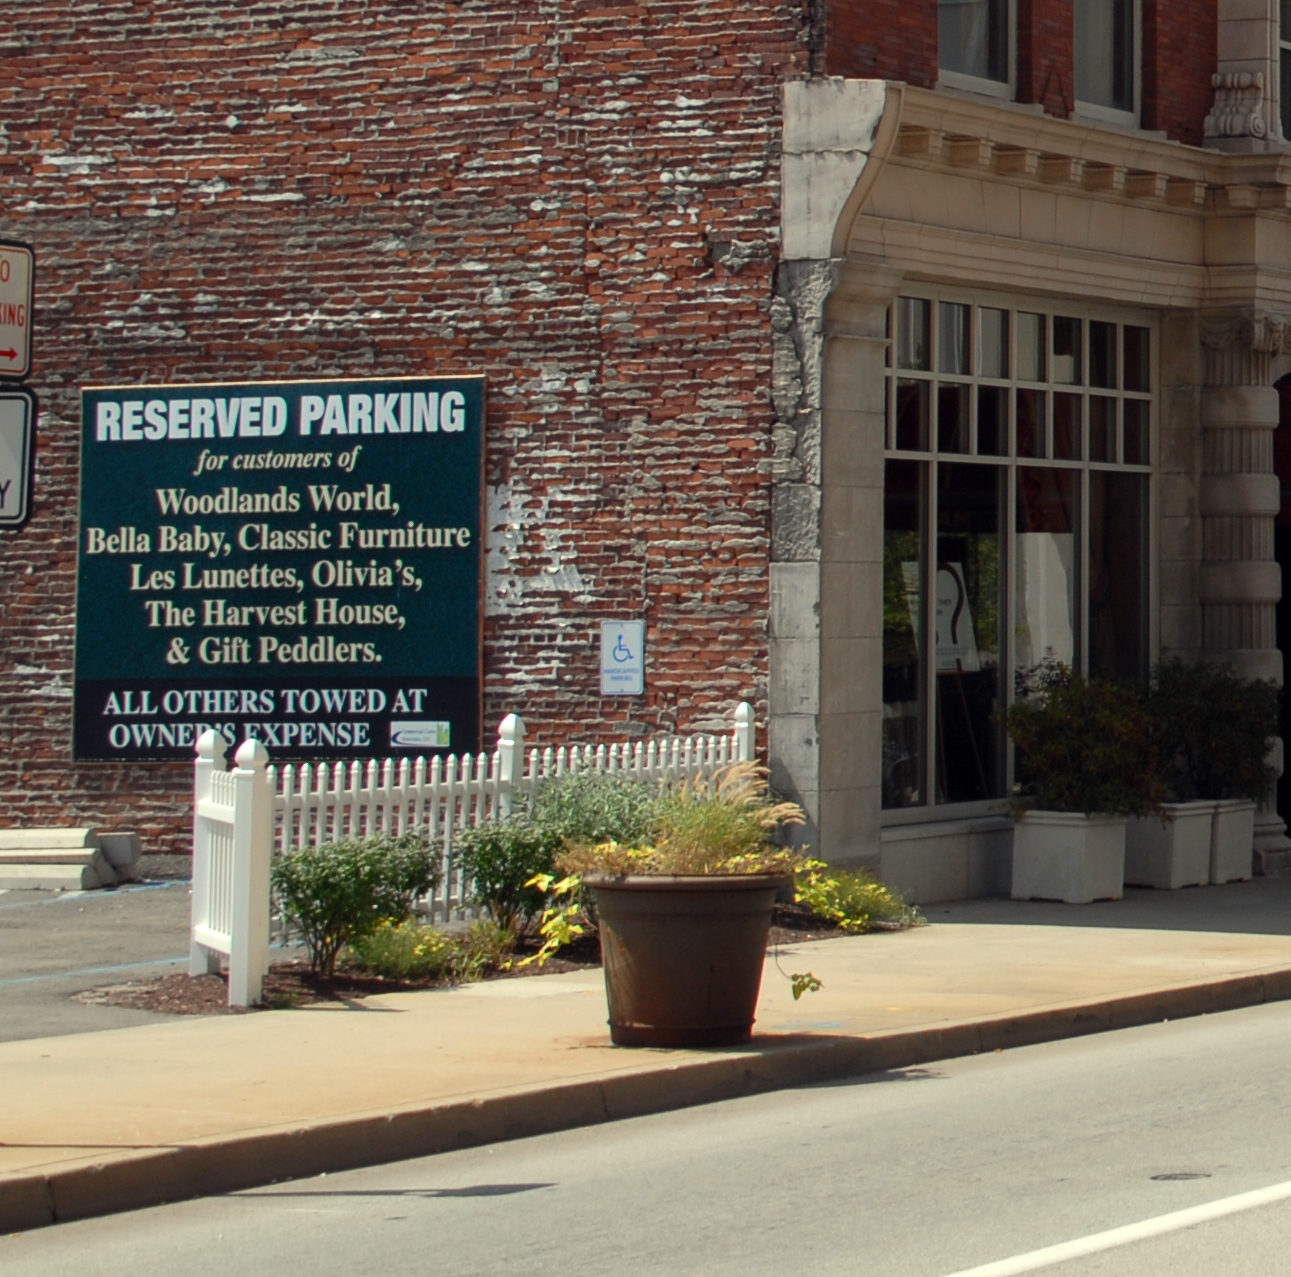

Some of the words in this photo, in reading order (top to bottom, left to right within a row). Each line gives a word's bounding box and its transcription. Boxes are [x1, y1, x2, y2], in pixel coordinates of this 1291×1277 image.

[96, 396, 288, 442] RESERVED
[299, 391, 466, 436] PARKING
[193, 448, 229, 476] for
[233, 450, 331, 470] customers
[337, 445, 362, 472] of
[155, 485, 300, 515] Woodlands
[306, 483, 400, 515] World,
[86, 526, 151, 554] Bella
[157, 524, 232, 557] Baby,
[238, 523, 332, 550] Classic
[338, 521, 471, 550] Furniture
[130, 563, 176, 591] Les
[183, 561, 304, 592] Lunettes,
[311, 559, 423, 592] Olivia's,
[144, 599, 196, 627] The
[202, 599, 307, 626] Harvest
[313, 598, 406, 629] House,
[166, 637, 190, 664] &
[198, 636, 252, 664] Gift
[258, 635, 382, 663] Peddlers.
[103, 690, 159, 715] ALL
[162, 690, 275, 714] OTHERS
[281, 689, 387, 714] TOWED
[391, 688, 428, 713] AT
[244, 722, 371, 748] EXPENSE
